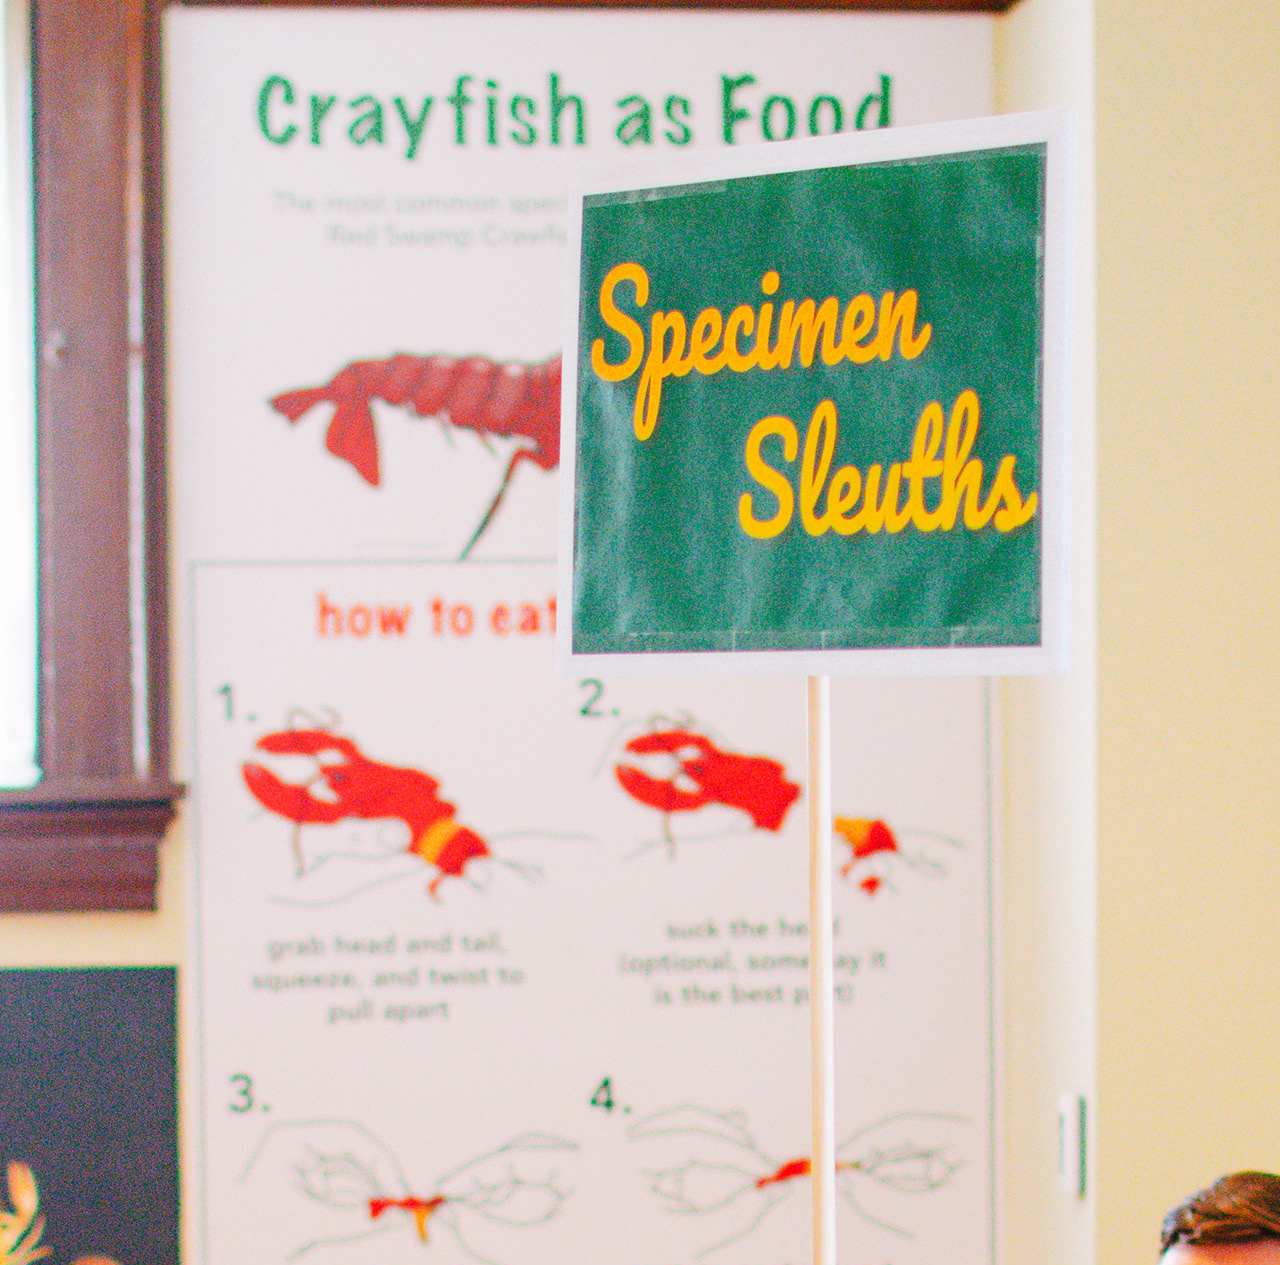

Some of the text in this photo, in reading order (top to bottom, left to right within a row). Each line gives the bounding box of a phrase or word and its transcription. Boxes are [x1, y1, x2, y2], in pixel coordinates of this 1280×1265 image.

[256, 71, 894, 160] Crayfish as Food
[591, 261, 932, 441] Specimen
[738, 389, 1038, 539] Sleuths
[317, 591, 411, 638] how
[431, 595, 475, 637] to
[216, 682, 257, 723] 1.
[578, 677, 620, 718] 2.
[333, 932, 397, 955] head
[405, 931, 452, 955] and
[728, 917, 769, 938] the
[372, 965, 419, 987] and
[427, 965, 488, 986] twist
[496, 966, 524, 985] to
[681, 981, 721, 1004] the
[729, 981, 784, 1004] best
[326, 997, 450, 1025] pull apart
[227, 1072, 271, 1114] 3.
[589, 1075, 632, 1115] 4.
